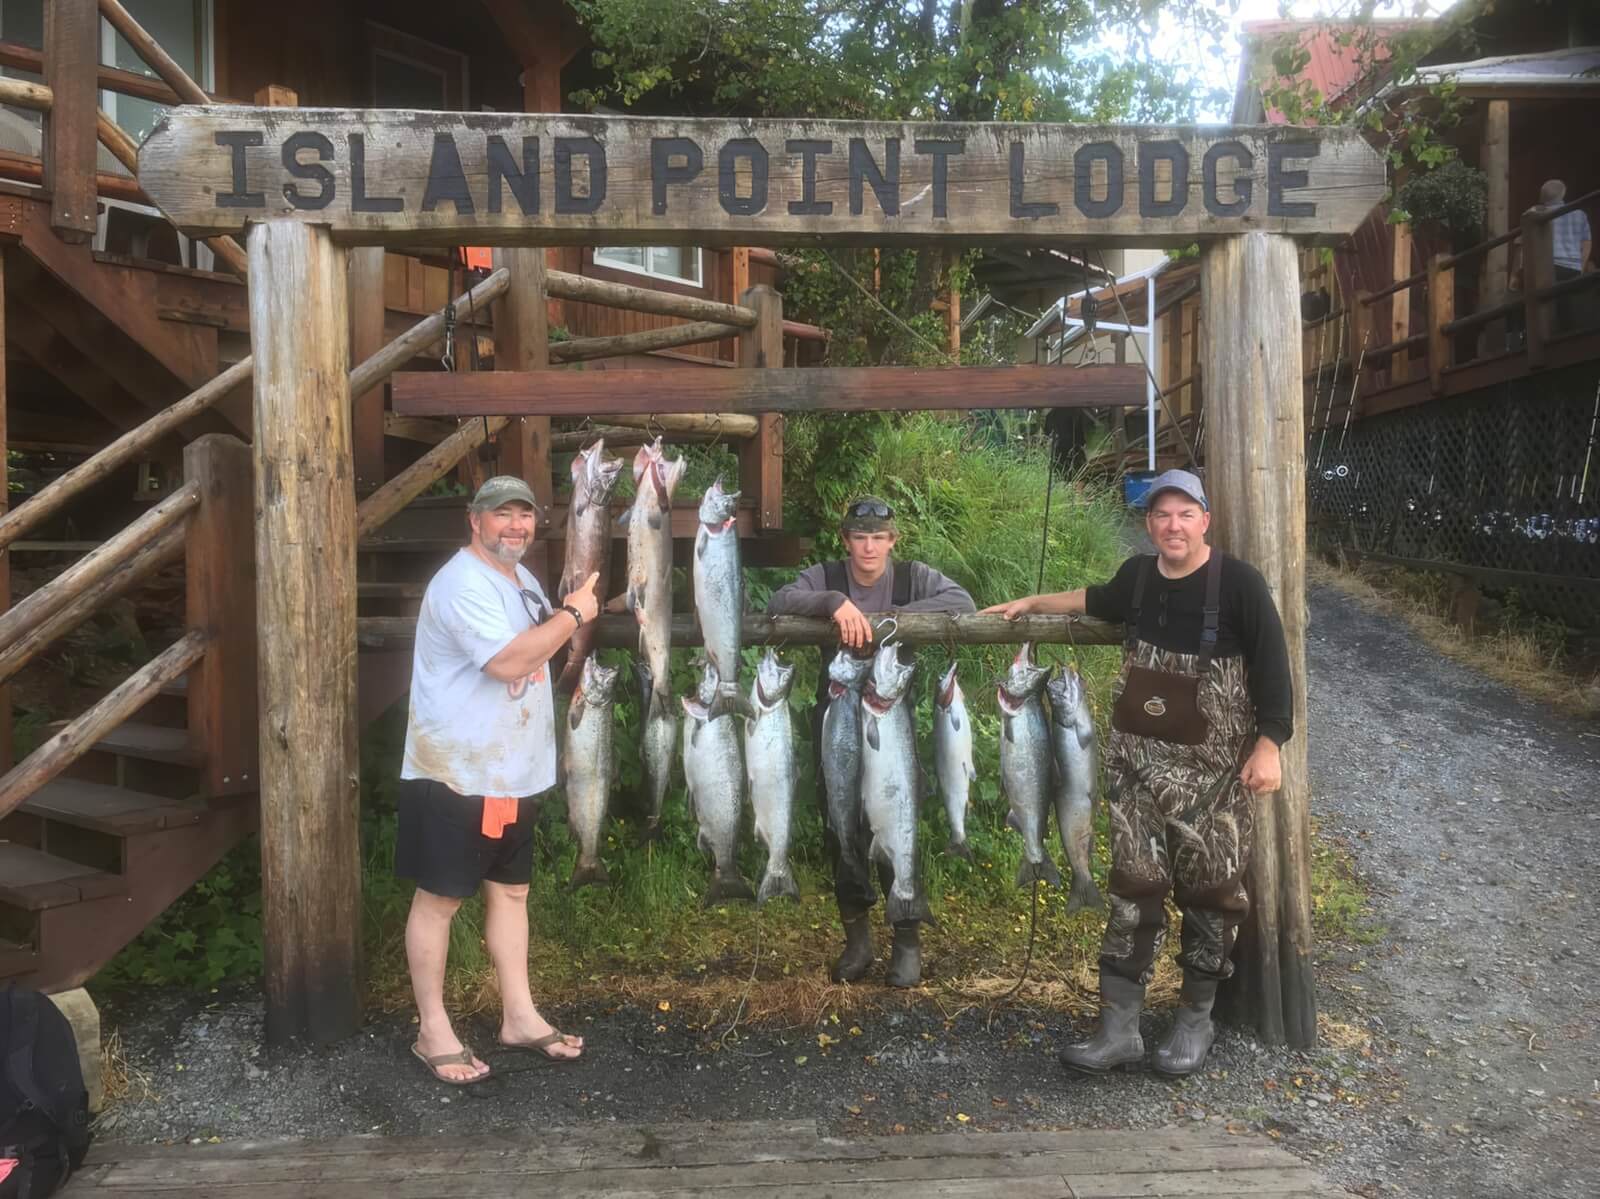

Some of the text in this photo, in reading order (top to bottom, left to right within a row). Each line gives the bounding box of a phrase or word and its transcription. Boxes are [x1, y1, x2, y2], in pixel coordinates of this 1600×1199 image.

[214, 131, 1320, 219] ISLAND POINT LODGE
